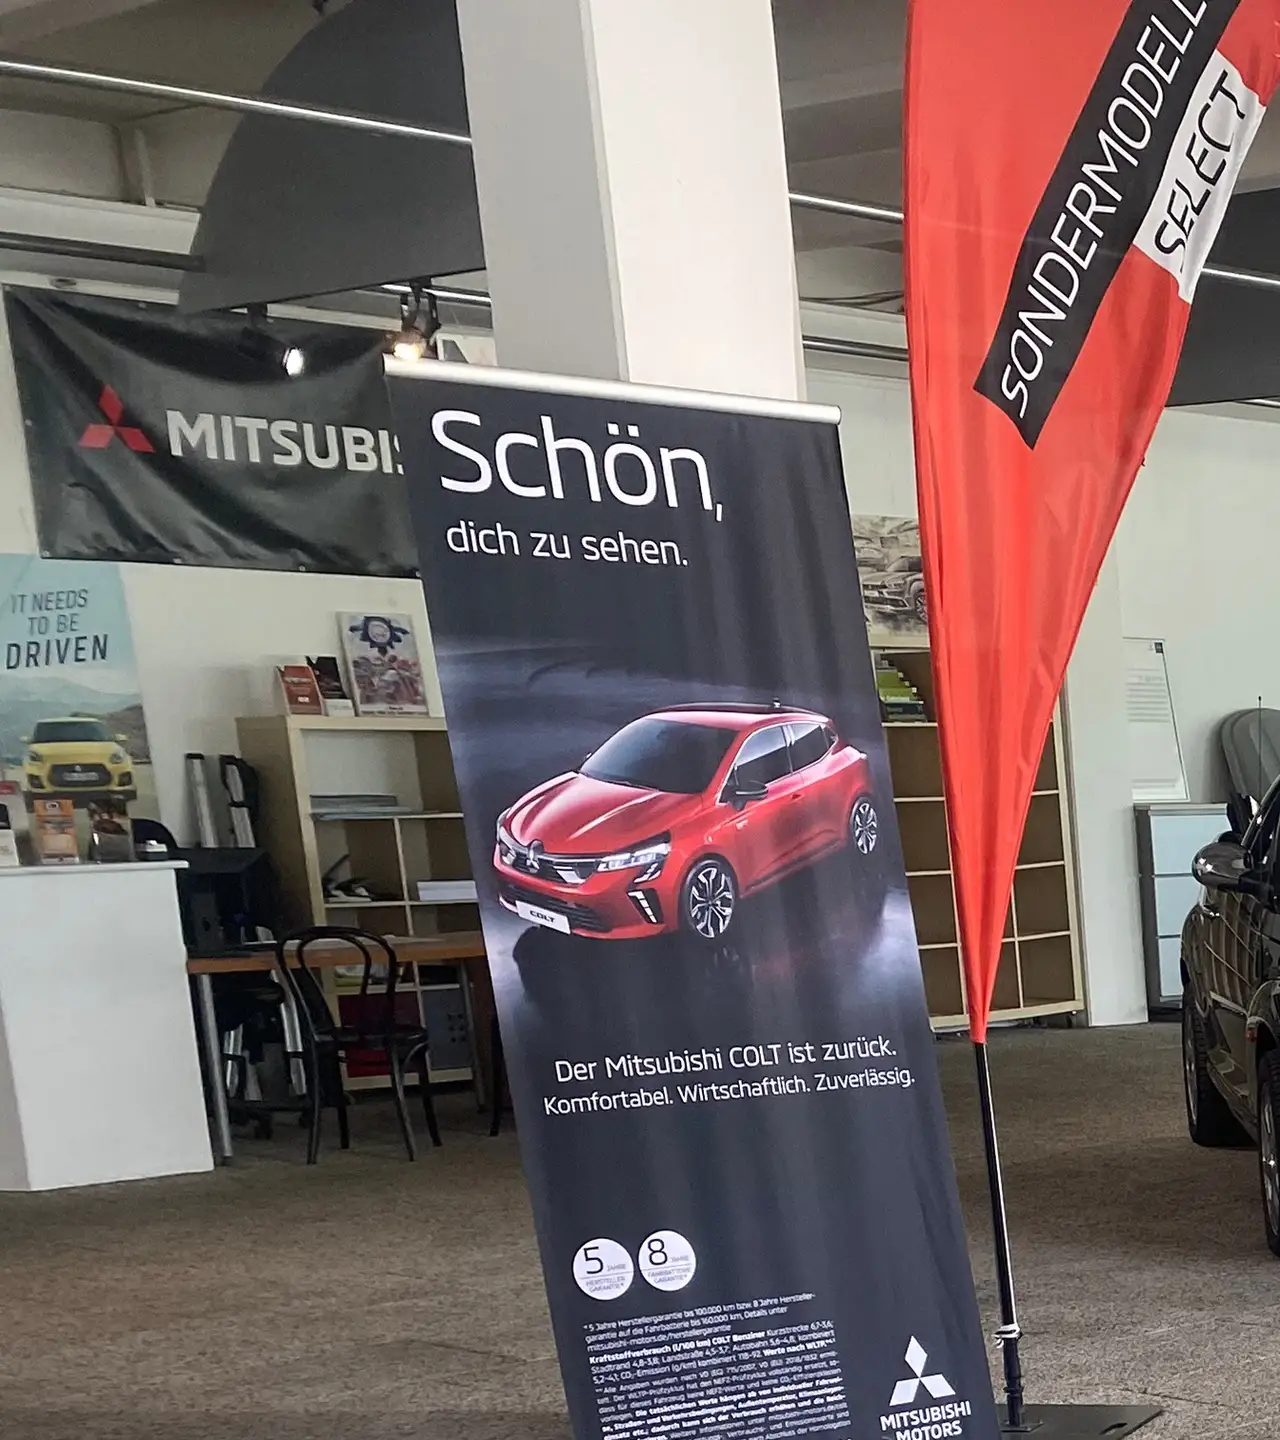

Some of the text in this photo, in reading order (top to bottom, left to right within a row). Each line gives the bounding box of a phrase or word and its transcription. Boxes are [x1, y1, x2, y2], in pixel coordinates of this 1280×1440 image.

[1155, 70, 1246, 272] SELECT
[167, 410, 404, 475] MITSUBI
[431, 410, 723, 521] Schön,
[447, 520, 688, 566] dich zu sehen.
[10, 589, 88, 613] IT NEEDS
[28, 613, 80, 635] TO BE
[6, 634, 108, 669] DRIVEN
[530, 910, 555, 923] COLT
[555, 1036, 896, 1082] Der Mitsubishi COLT ist zurück.
[544, 1067, 916, 1115] Komfortabel. Wirtschaftlich. Zuverlässig.
[583, 1246, 604, 1275] 5
[648, 1238, 668, 1266] 8
[711, 1337, 730, 1345] COLT
[880, 1400, 971, 1431] MITSUBISHI
